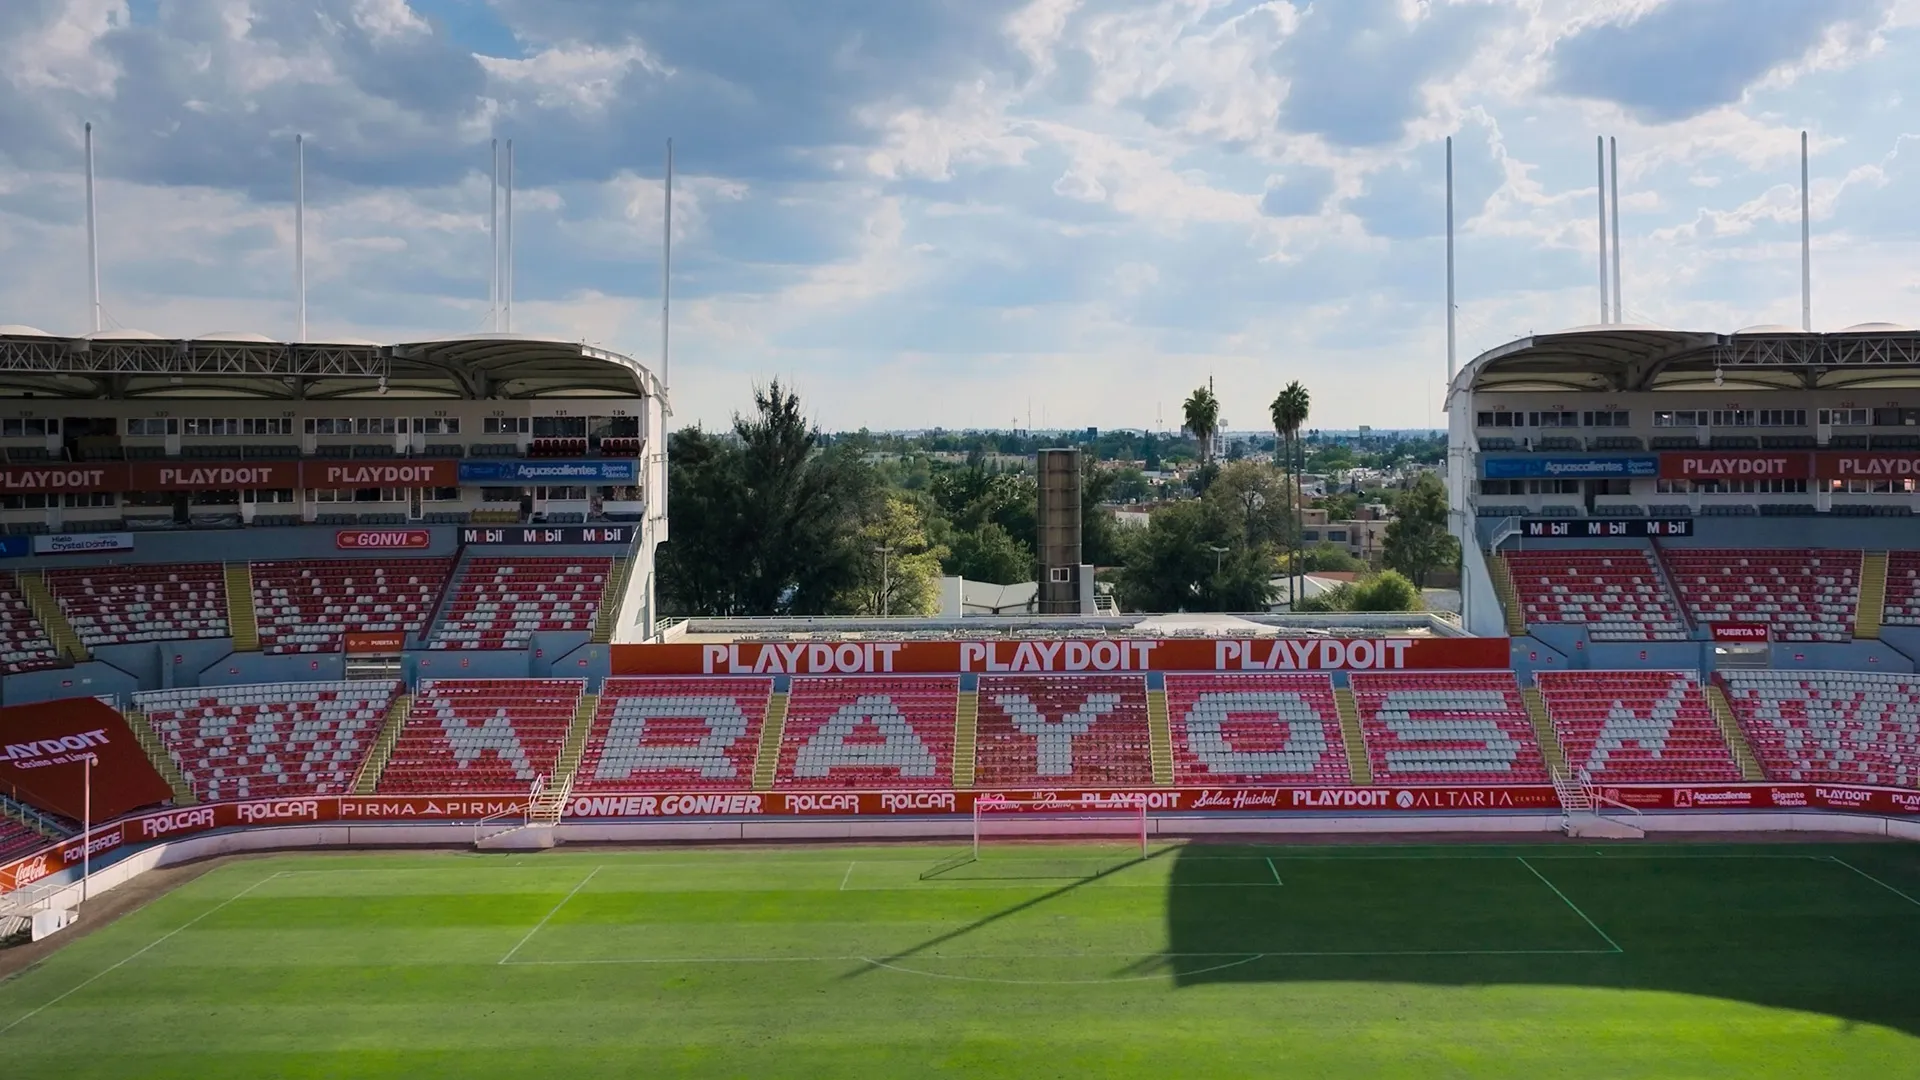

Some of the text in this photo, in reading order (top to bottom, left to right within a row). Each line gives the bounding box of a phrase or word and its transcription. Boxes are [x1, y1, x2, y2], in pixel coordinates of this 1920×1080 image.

[517, 464, 597, 478] Aguascalientes
[1544, 461, 1623, 474] Aguascalientes
[1683, 458, 1787, 474] PLAYDOIT
[160, 467, 273, 485] PLAYDOIT
[328, 466, 434, 482] PLAYDOIT
[464, 528, 621, 543] Mobil Mobil Mobil
[1530, 521, 1685, 535] Mobil Mobil Mobil
[357, 533, 407, 546] GONVI
[1716, 628, 1766, 636] PUERTA 10
[371, 639, 393, 647] PUERTA
[703, 639, 1412, 674] PLAYDOIT PLAYDOIT PLAYDOIT
[14, 757, 52, 769] Casino
[53, 756, 69, 765] en
[1081, 792, 1181, 808] PLAYDOIT
[1191, 788, 1279, 809] Salsa Huichol
[1293, 790, 1389, 806] PLAYDOIT
[1416, 791, 1513, 806] ALTARIA
[1693, 791, 1752, 801] Aguascalientes
[1771, 792, 1805, 801] gigante
[1815, 788, 1872, 802] PLAYDOIT
[342, 802, 521, 815] PIRMA PIRMA
[562, 794, 761, 816] GONHER GONHER
[785, 792, 955, 814] ROLCAR ROLCAR
[1779, 799, 1807, 807] México
[237, 800, 318, 823] ROLCAR
[143, 808, 214, 837] ROLCAR
[64, 831, 121, 863] POWERADE
